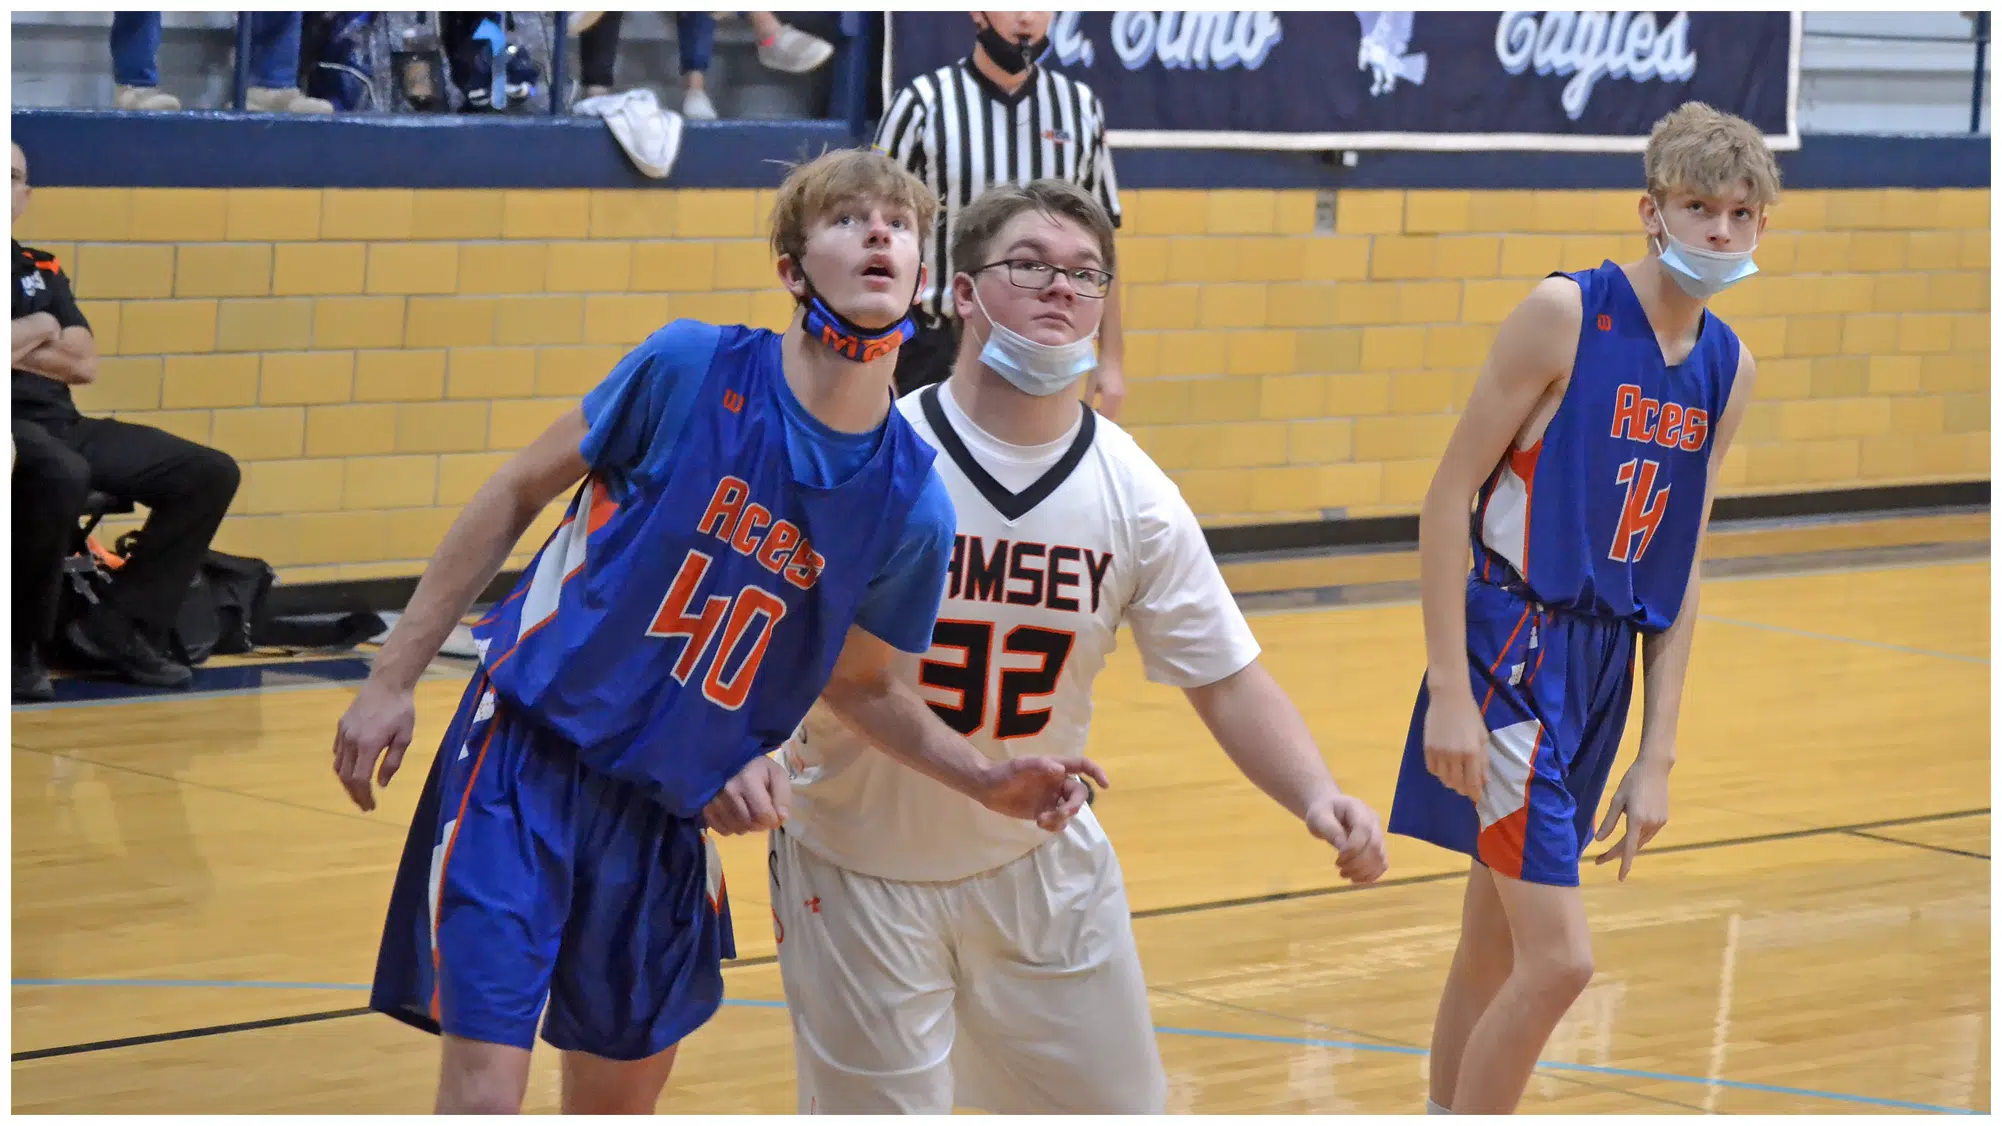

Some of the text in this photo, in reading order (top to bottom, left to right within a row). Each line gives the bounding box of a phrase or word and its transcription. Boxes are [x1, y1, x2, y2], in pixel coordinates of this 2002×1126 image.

[1495, 11, 1697, 120] Eagles
[1610, 384, 1708, 452] Aces
[697, 475, 825, 590] Aces
[1608, 457, 1671, 563] 14
[645, 548, 787, 711] 40
[918, 617, 1076, 740] 32
